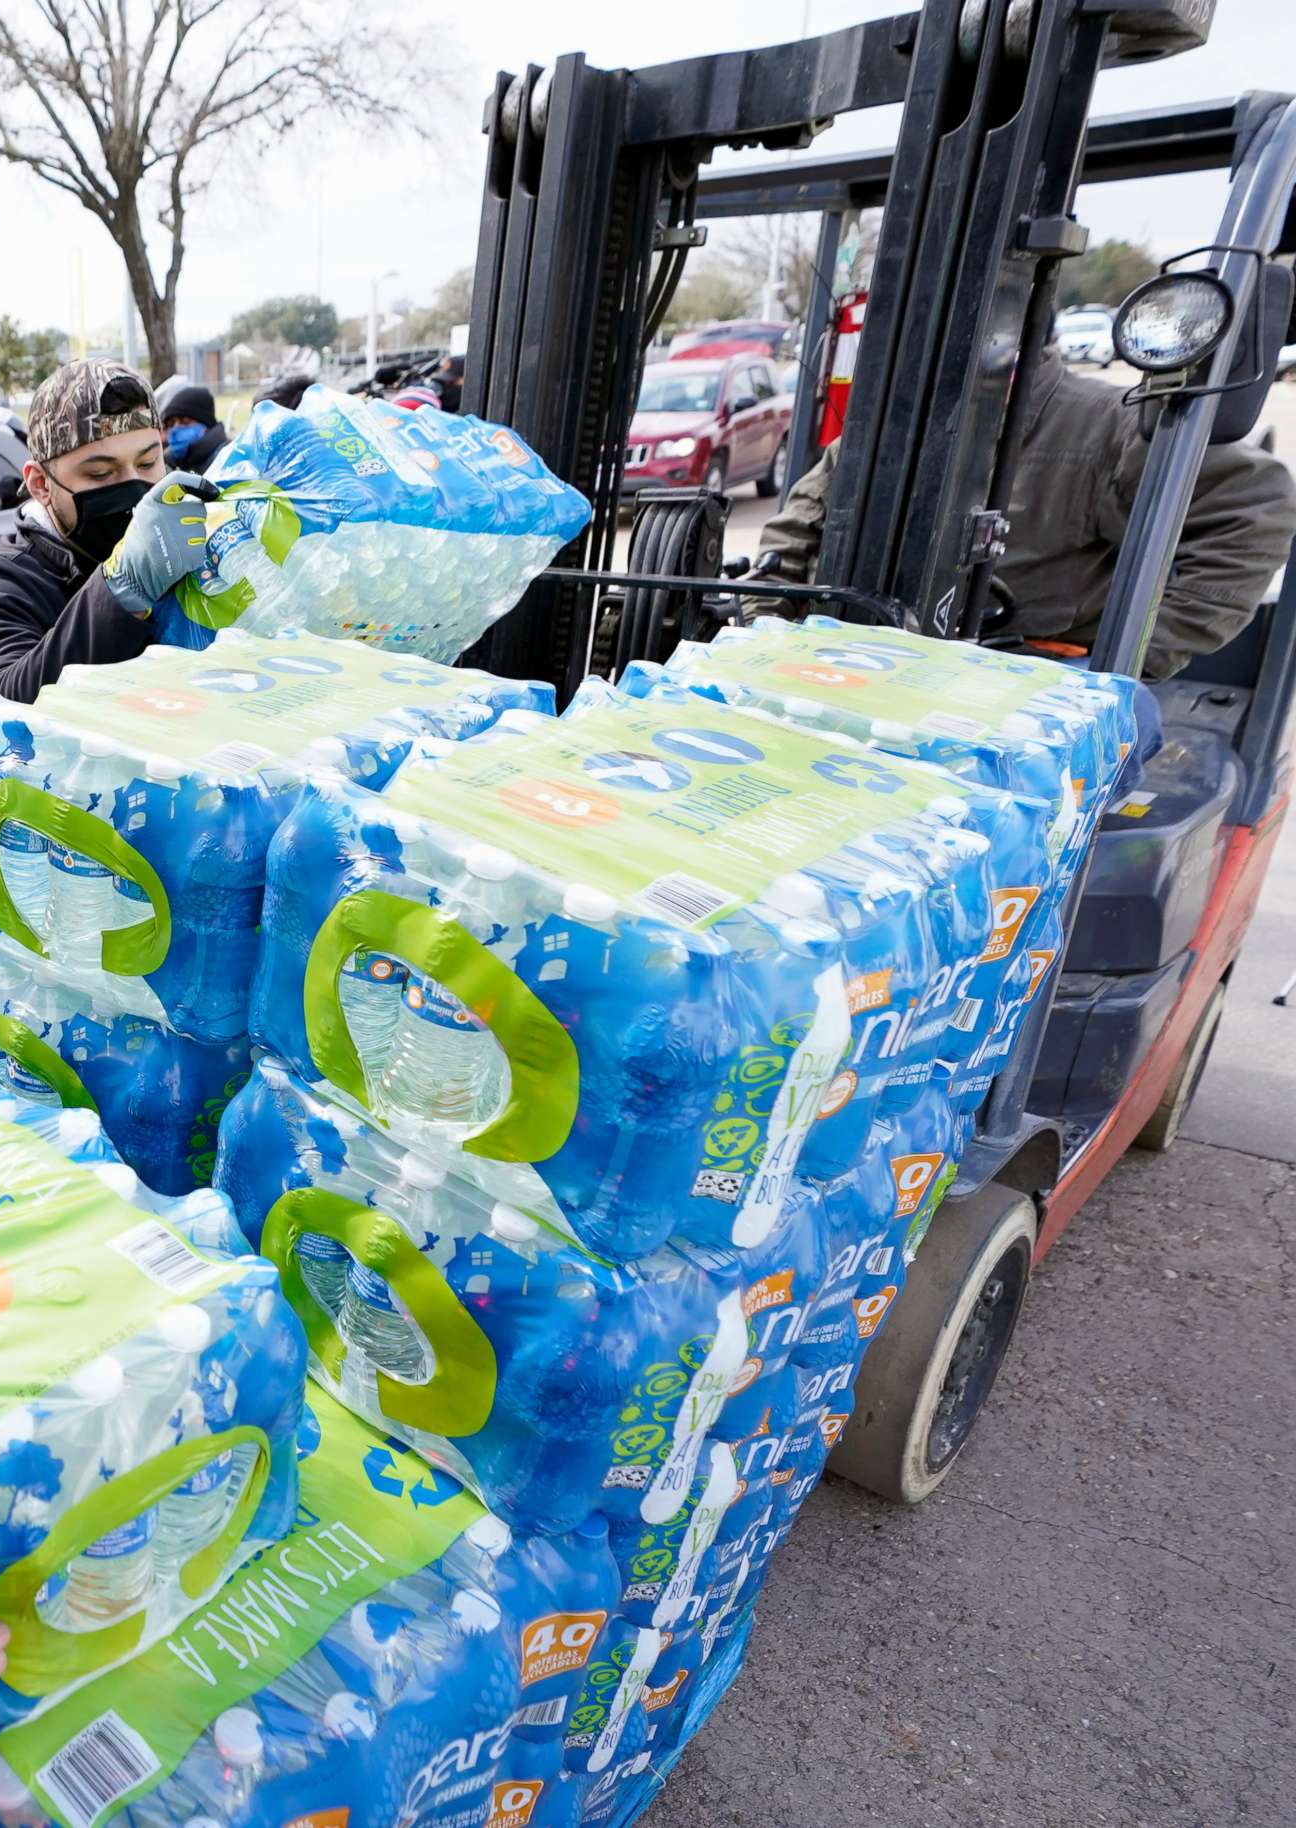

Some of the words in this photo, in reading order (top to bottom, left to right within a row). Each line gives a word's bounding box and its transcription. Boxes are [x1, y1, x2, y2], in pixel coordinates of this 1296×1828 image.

[279, 1520, 386, 1596] LET'S
[193, 1567, 311, 1671] MAKE
[526, 1622, 597, 1659] 40
[165, 1635, 219, 1688] A
